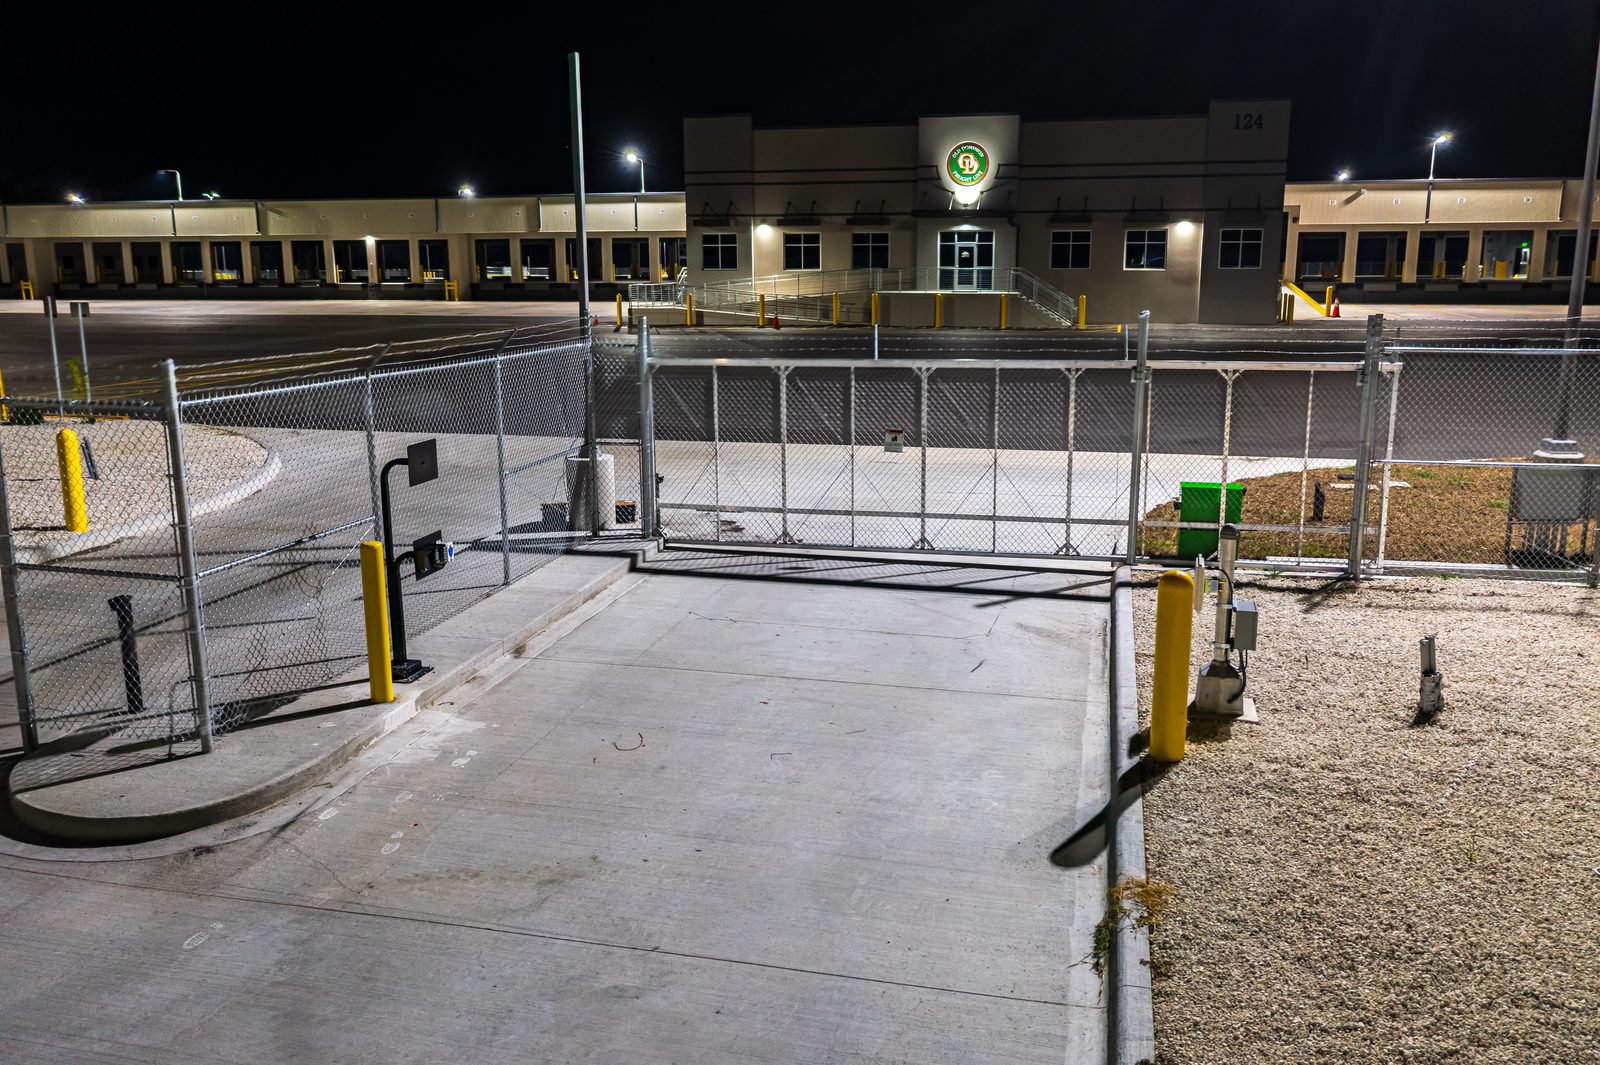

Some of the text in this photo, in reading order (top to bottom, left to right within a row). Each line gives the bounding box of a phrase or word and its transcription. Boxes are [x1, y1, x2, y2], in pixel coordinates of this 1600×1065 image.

[1233, 113, 1263, 129] 124
[952, 145, 984, 158] OLD DOMINION
[952, 170, 983, 182] FREIGHT LINE
